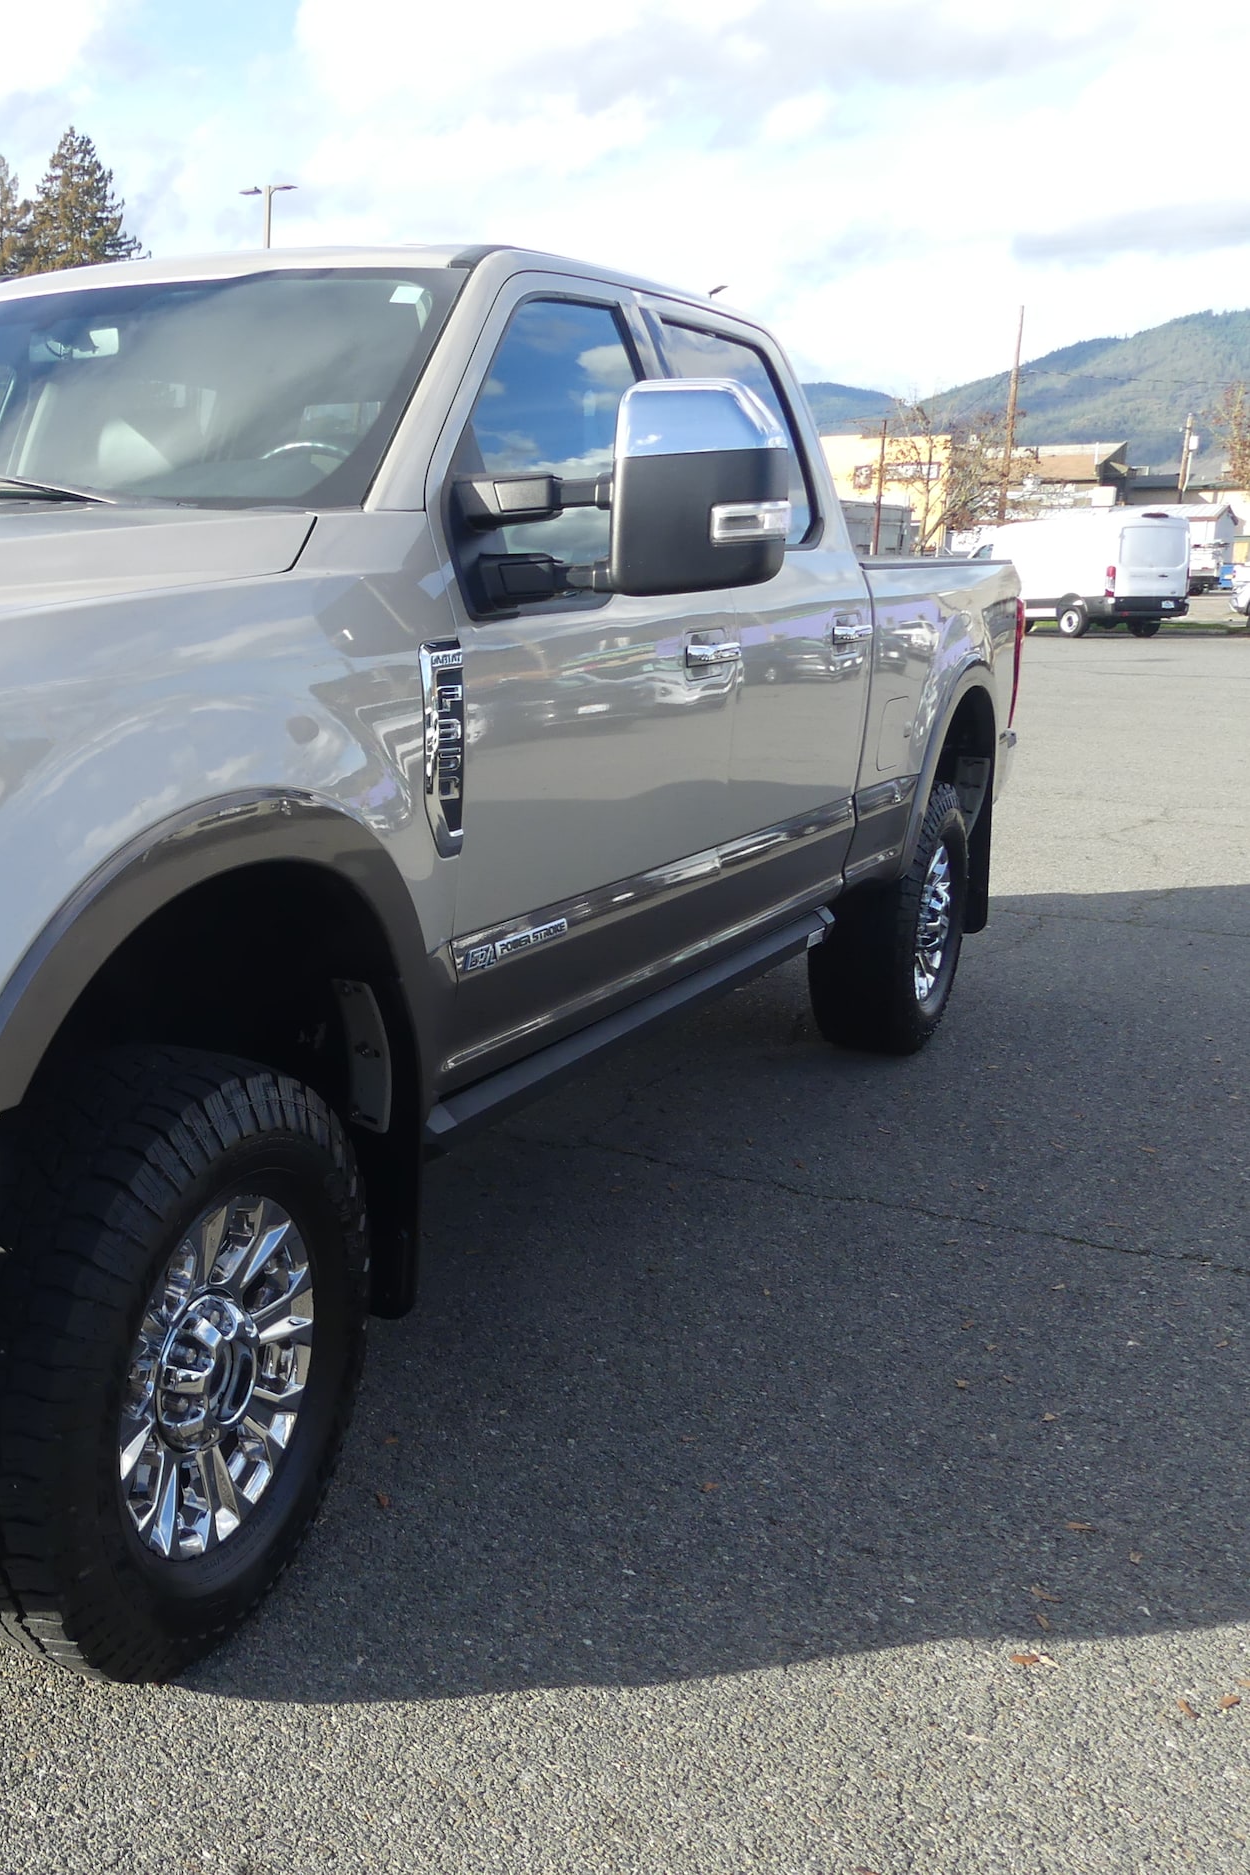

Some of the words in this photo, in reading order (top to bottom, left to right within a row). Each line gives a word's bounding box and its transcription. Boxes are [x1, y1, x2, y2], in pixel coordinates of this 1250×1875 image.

[430, 651, 462, 666] LARIAT
[498, 934, 531, 955] POWER
[531, 921, 567, 942] STROKE
